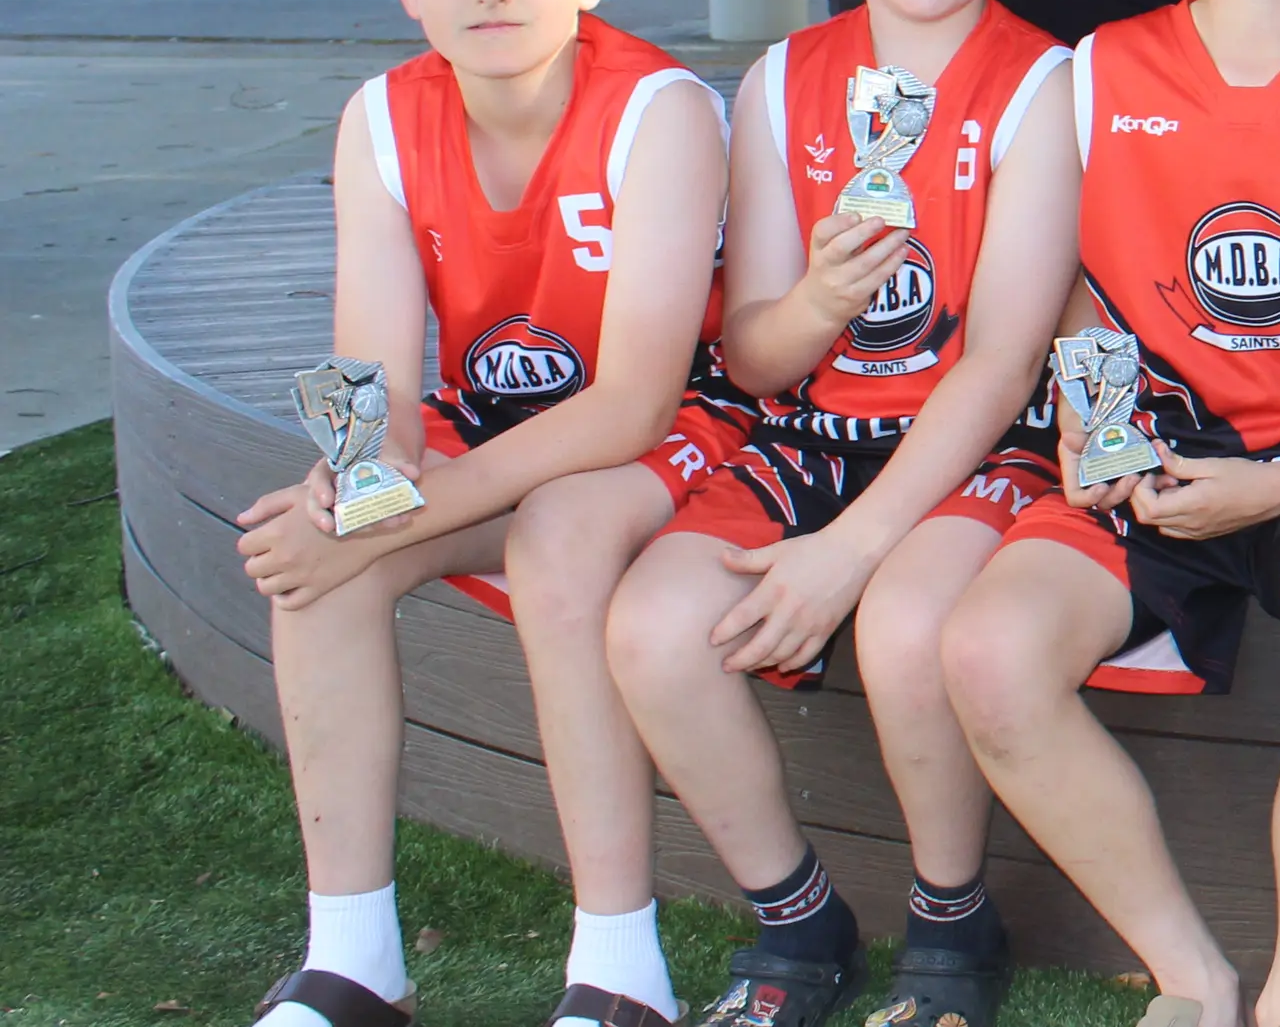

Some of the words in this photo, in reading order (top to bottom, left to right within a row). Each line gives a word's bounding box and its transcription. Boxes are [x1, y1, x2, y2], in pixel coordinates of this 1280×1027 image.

[558, 193, 613, 272] 5
[1231, 335, 1280, 351] SAINTS
[484, 348, 565, 390] M.D.B.A
[862, 361, 908, 375] SAINTS
